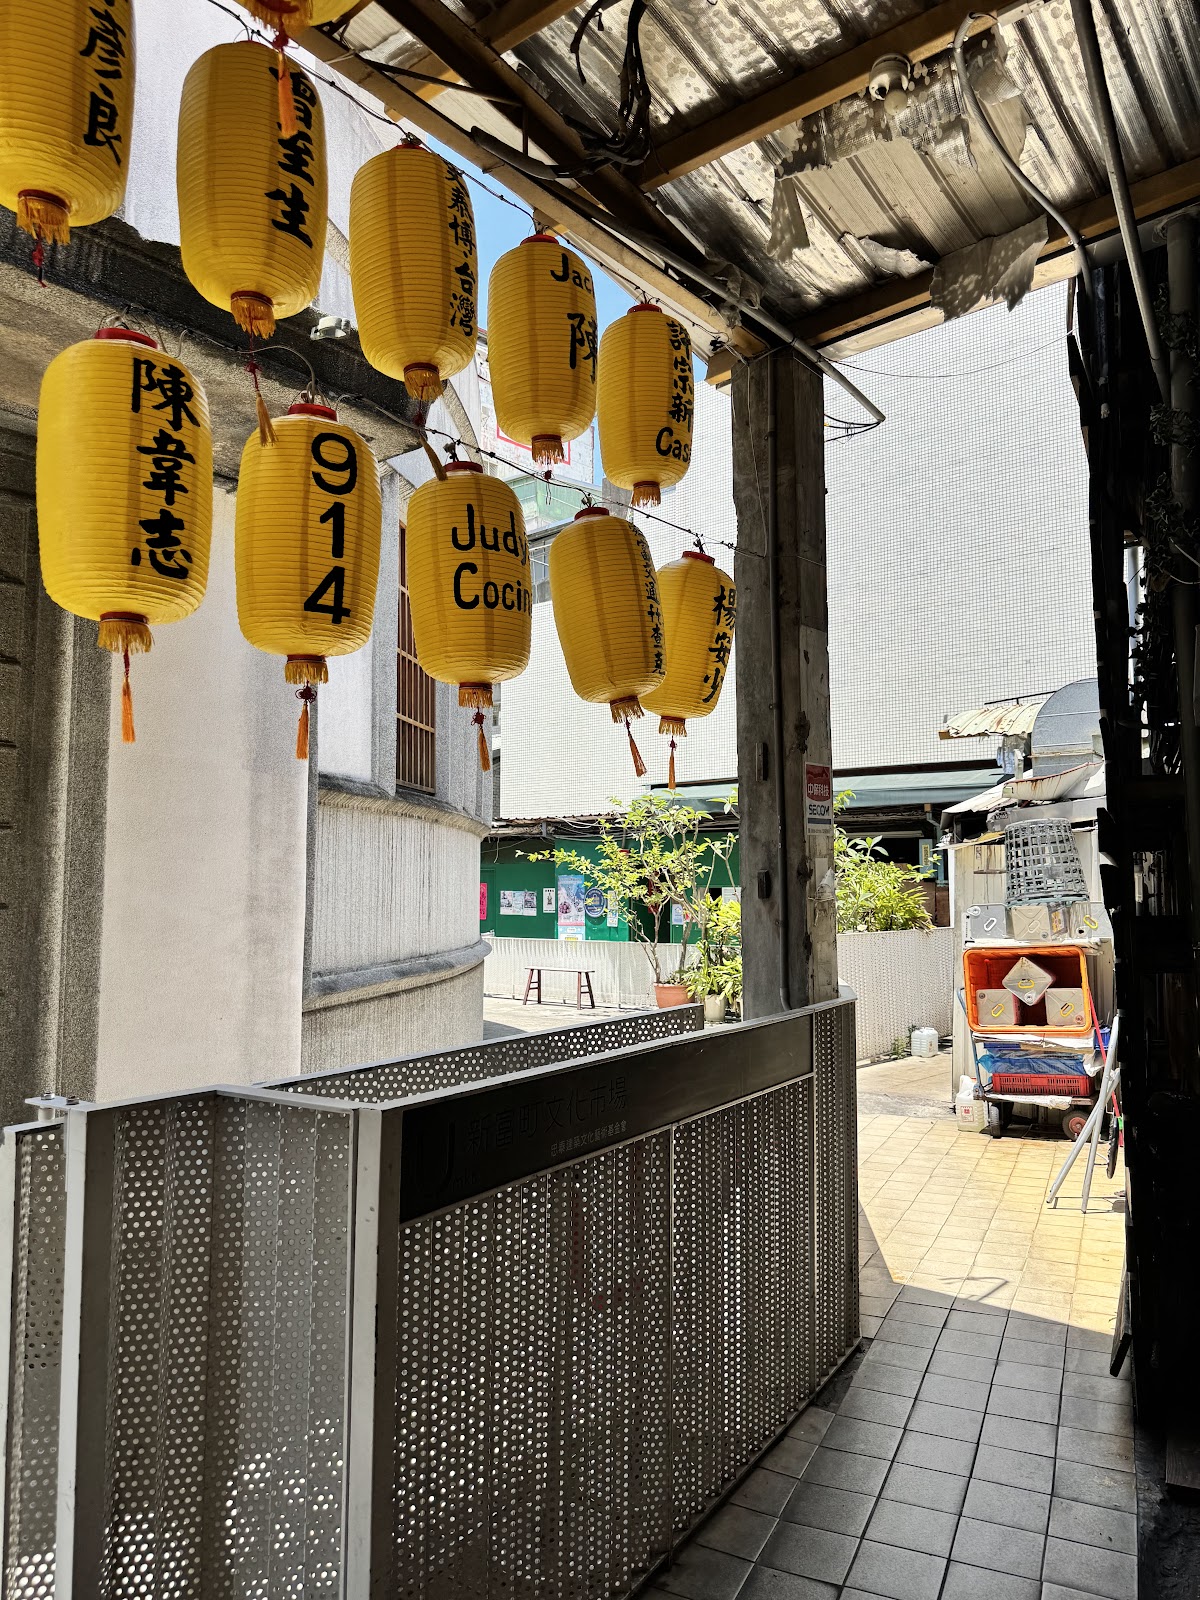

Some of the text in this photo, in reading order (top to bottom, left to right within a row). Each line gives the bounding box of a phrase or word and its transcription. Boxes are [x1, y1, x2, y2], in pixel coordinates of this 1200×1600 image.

[80, 0, 127, 166] 彥良
[550, 253, 595, 299] Jac
[131, 356, 201, 580] 陳韋志
[656, 426, 692, 464] Cas
[303, 432, 358, 625] 914
[451, 503, 531, 567] Judy
[453, 562, 533, 620] Cocin
[466, 1076, 628, 1154] 新富町文化市場
